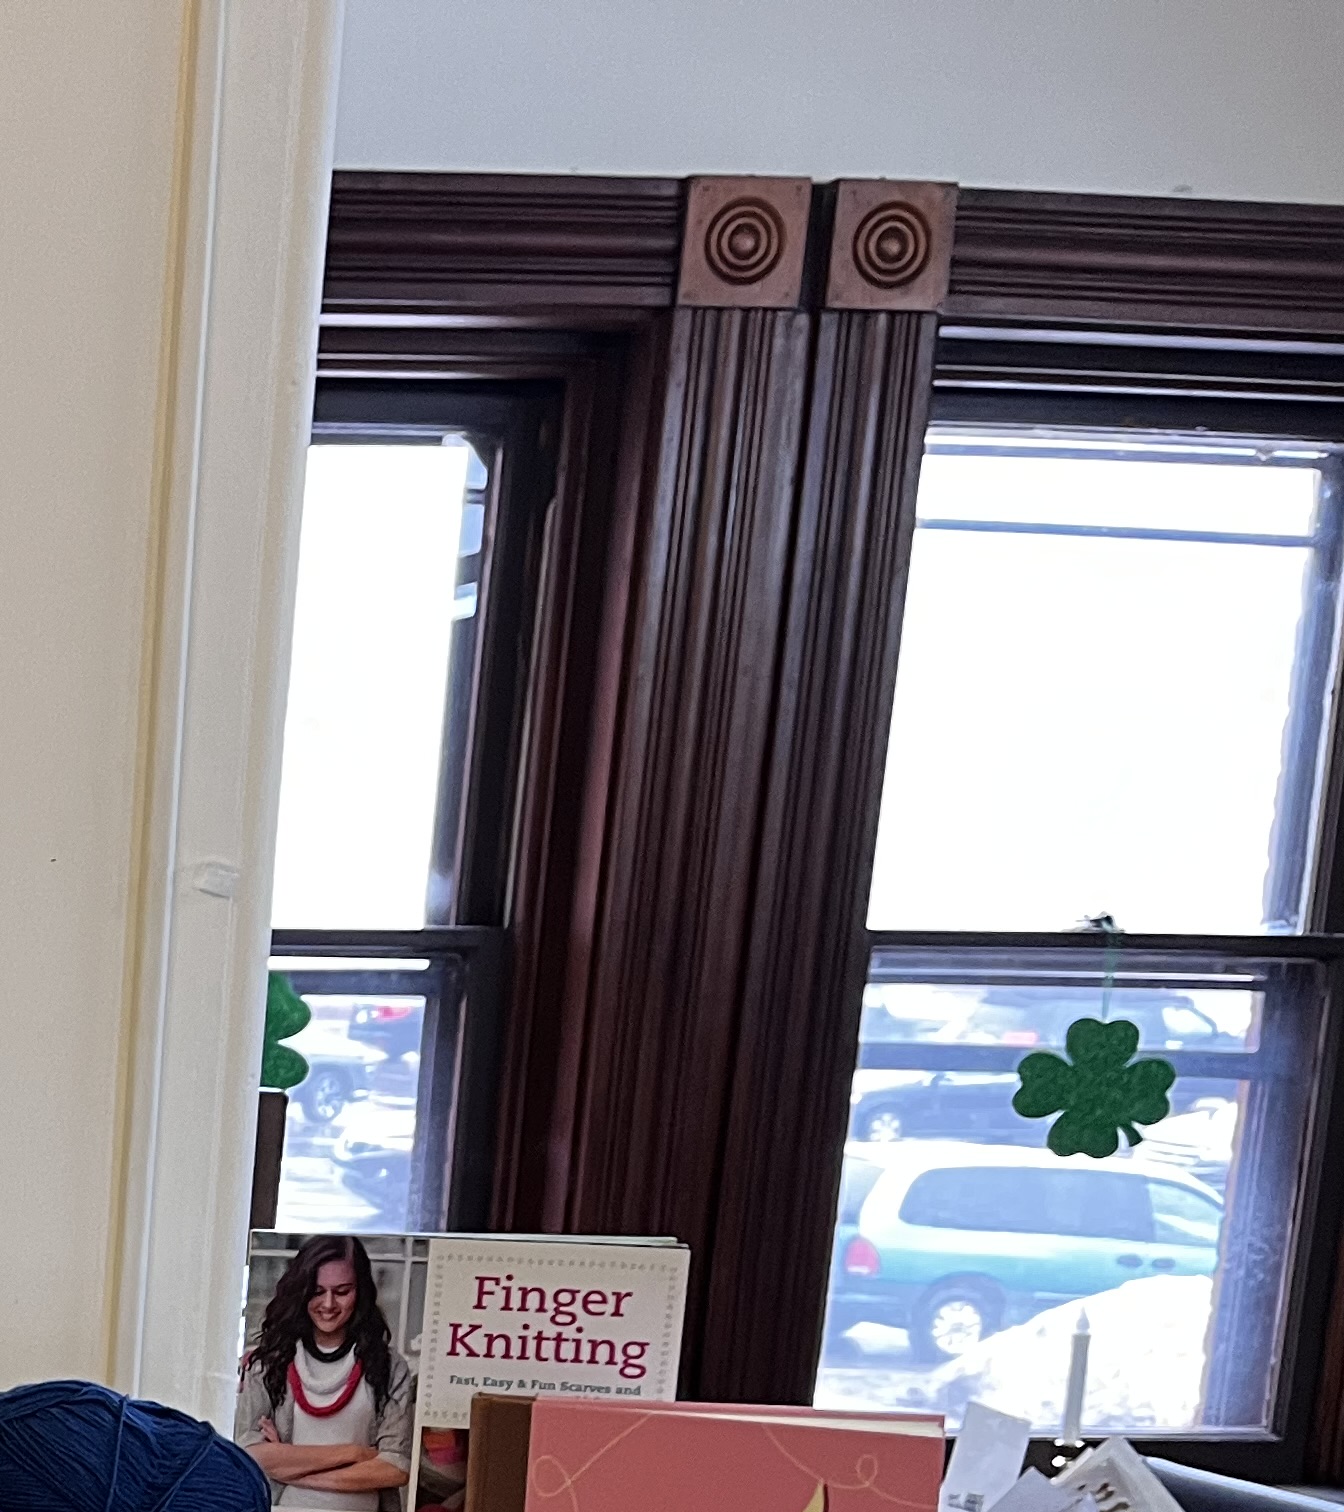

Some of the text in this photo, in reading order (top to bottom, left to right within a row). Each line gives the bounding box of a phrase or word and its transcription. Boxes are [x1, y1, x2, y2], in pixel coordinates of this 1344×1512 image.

[472, 1274, 634, 1326] Finger
[447, 1323, 650, 1379] Knitting
[449, 1375, 642, 1396] Fast, Easy & Fun Scarves and
